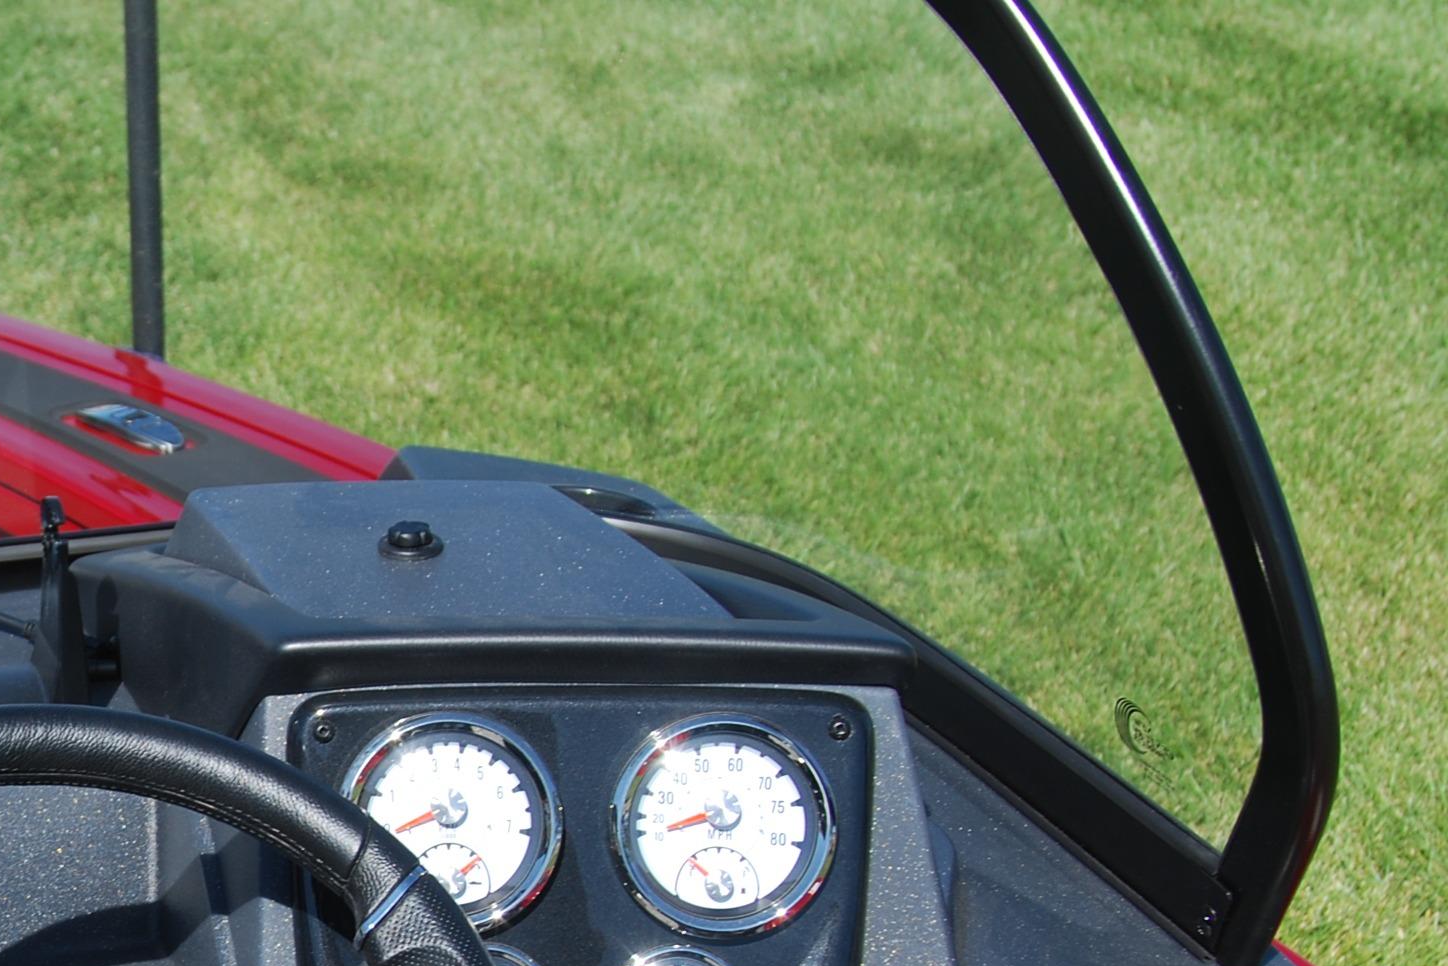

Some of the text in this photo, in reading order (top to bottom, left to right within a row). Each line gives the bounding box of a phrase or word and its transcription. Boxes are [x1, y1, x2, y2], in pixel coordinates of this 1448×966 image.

[694, 758, 709, 773] 50
[728, 758, 743, 772] 60
[477, 766, 484, 780] 5
[673, 772, 687, 785] 40
[758, 777, 772, 790] 70
[497, 786, 503, 799] 6
[658, 791, 674, 804] 30
[771, 800, 785, 813] 75
[652, 813, 665, 824] 20
[506, 820, 512, 833] 7
[770, 833, 786, 846] 80
